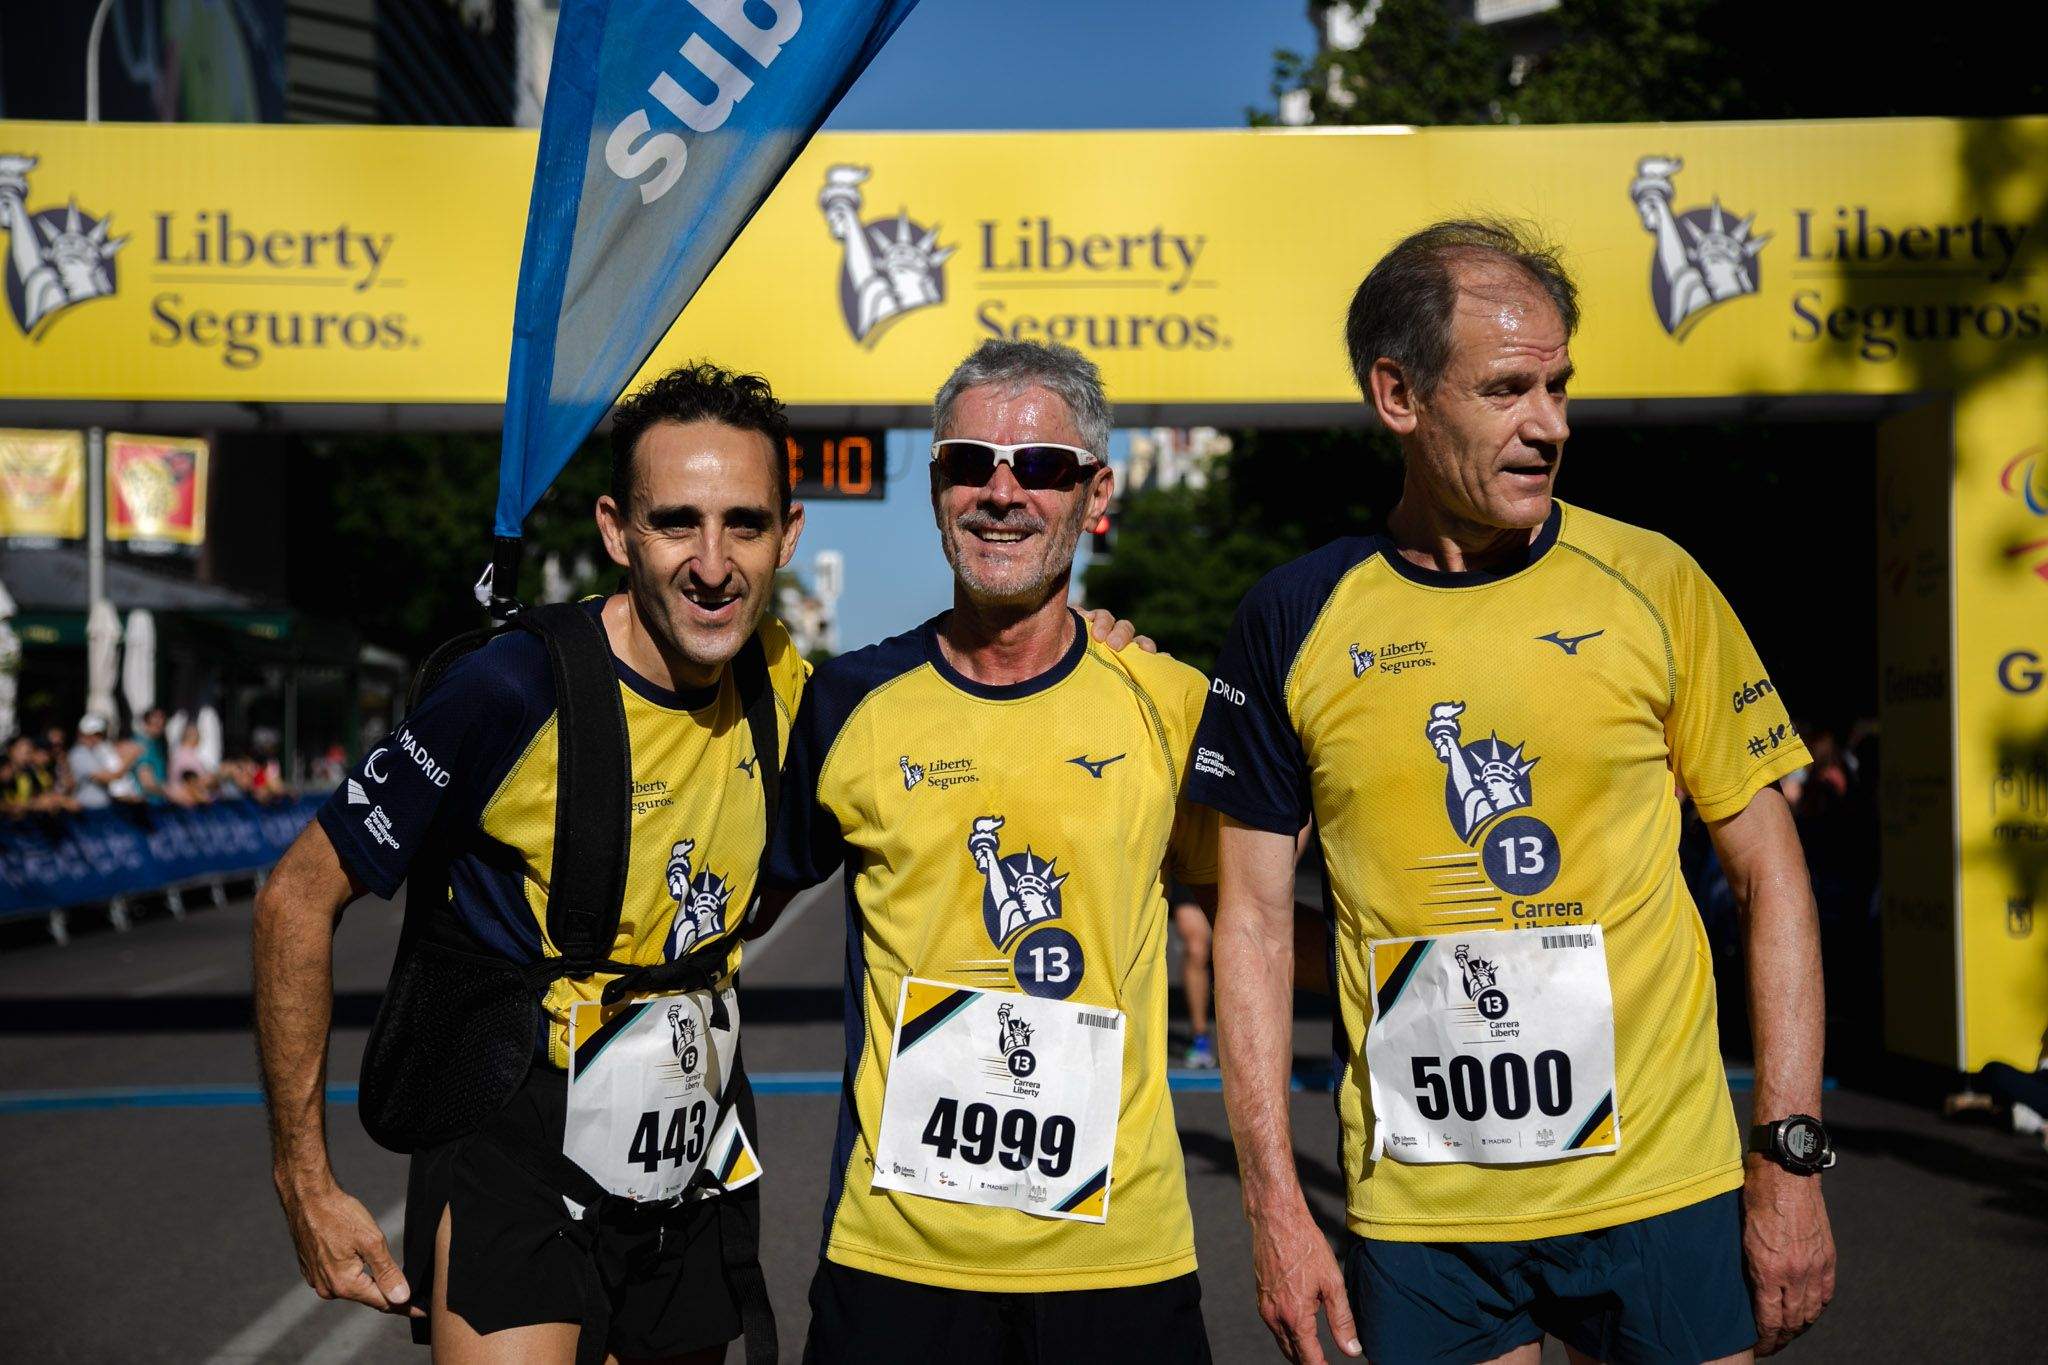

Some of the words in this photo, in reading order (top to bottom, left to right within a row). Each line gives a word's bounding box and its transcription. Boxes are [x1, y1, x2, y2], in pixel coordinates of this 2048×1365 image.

[605, 0, 803, 205] sub
[154, 210, 394, 290] Liberty
[977, 216, 1208, 292] Liberty
[1795, 206, 2028, 283] Liberty
[150, 292, 422, 369] Seguros.
[1379, 640, 1428, 658] Liberty
[1380, 657, 1436, 675] Seguros.
[1208, 677, 1246, 706] DRID
[399, 728, 451, 788] MADRID
[928, 758, 973, 773] Liberty
[631, 780, 668, 795] iberty
[927, 773, 980, 790] Seguros.
[631, 797, 675, 815] eguros.
[1499, 836, 1545, 876] 13
[1511, 899, 1584, 919] Carrera
[1029, 946, 1071, 983] 13
[1483, 996, 1503, 1013] 13
[1489, 1020, 1520, 1029] Carrera
[1490, 1029, 1520, 1038] Liberty
[684, 1052, 696, 1069] 13
[1014, 1055, 1031, 1071] 13
[1012, 1085, 1040, 1098] Liberty
[1013, 1078, 1041, 1089] Carrera
[1411, 1049, 1573, 1122] 5000
[627, 1100, 707, 1174] 443
[921, 1096, 1076, 1178] 4999
